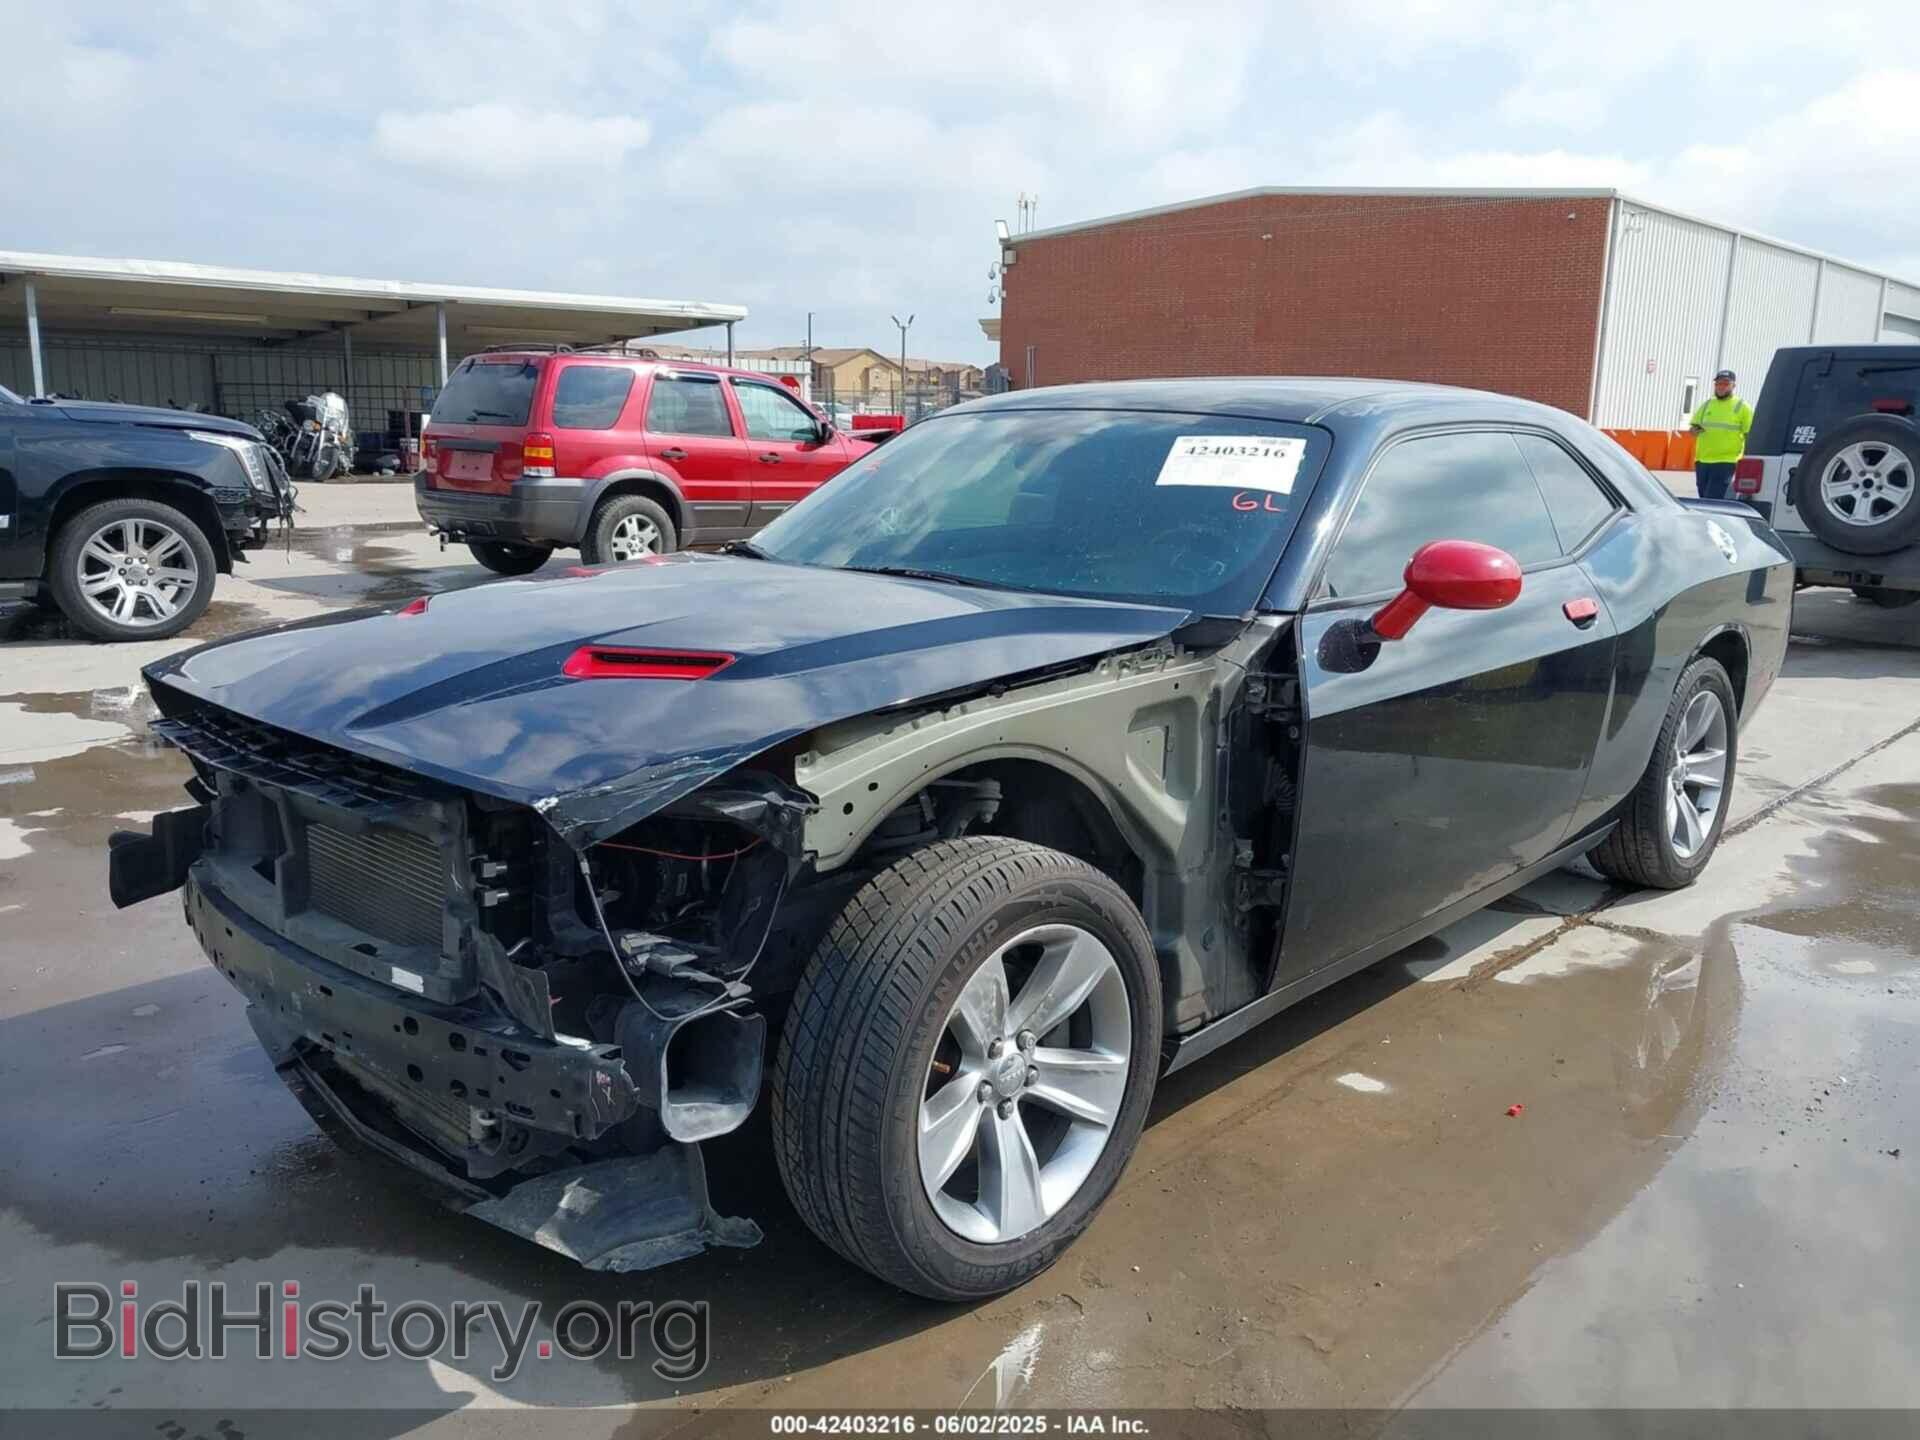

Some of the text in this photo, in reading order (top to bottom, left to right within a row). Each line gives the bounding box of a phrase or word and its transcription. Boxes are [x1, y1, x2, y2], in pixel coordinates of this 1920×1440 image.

[1794, 425, 1816, 435] KEL
[1791, 434, 1815, 444] TEC
[1184, 445, 1287, 458] 42403216
